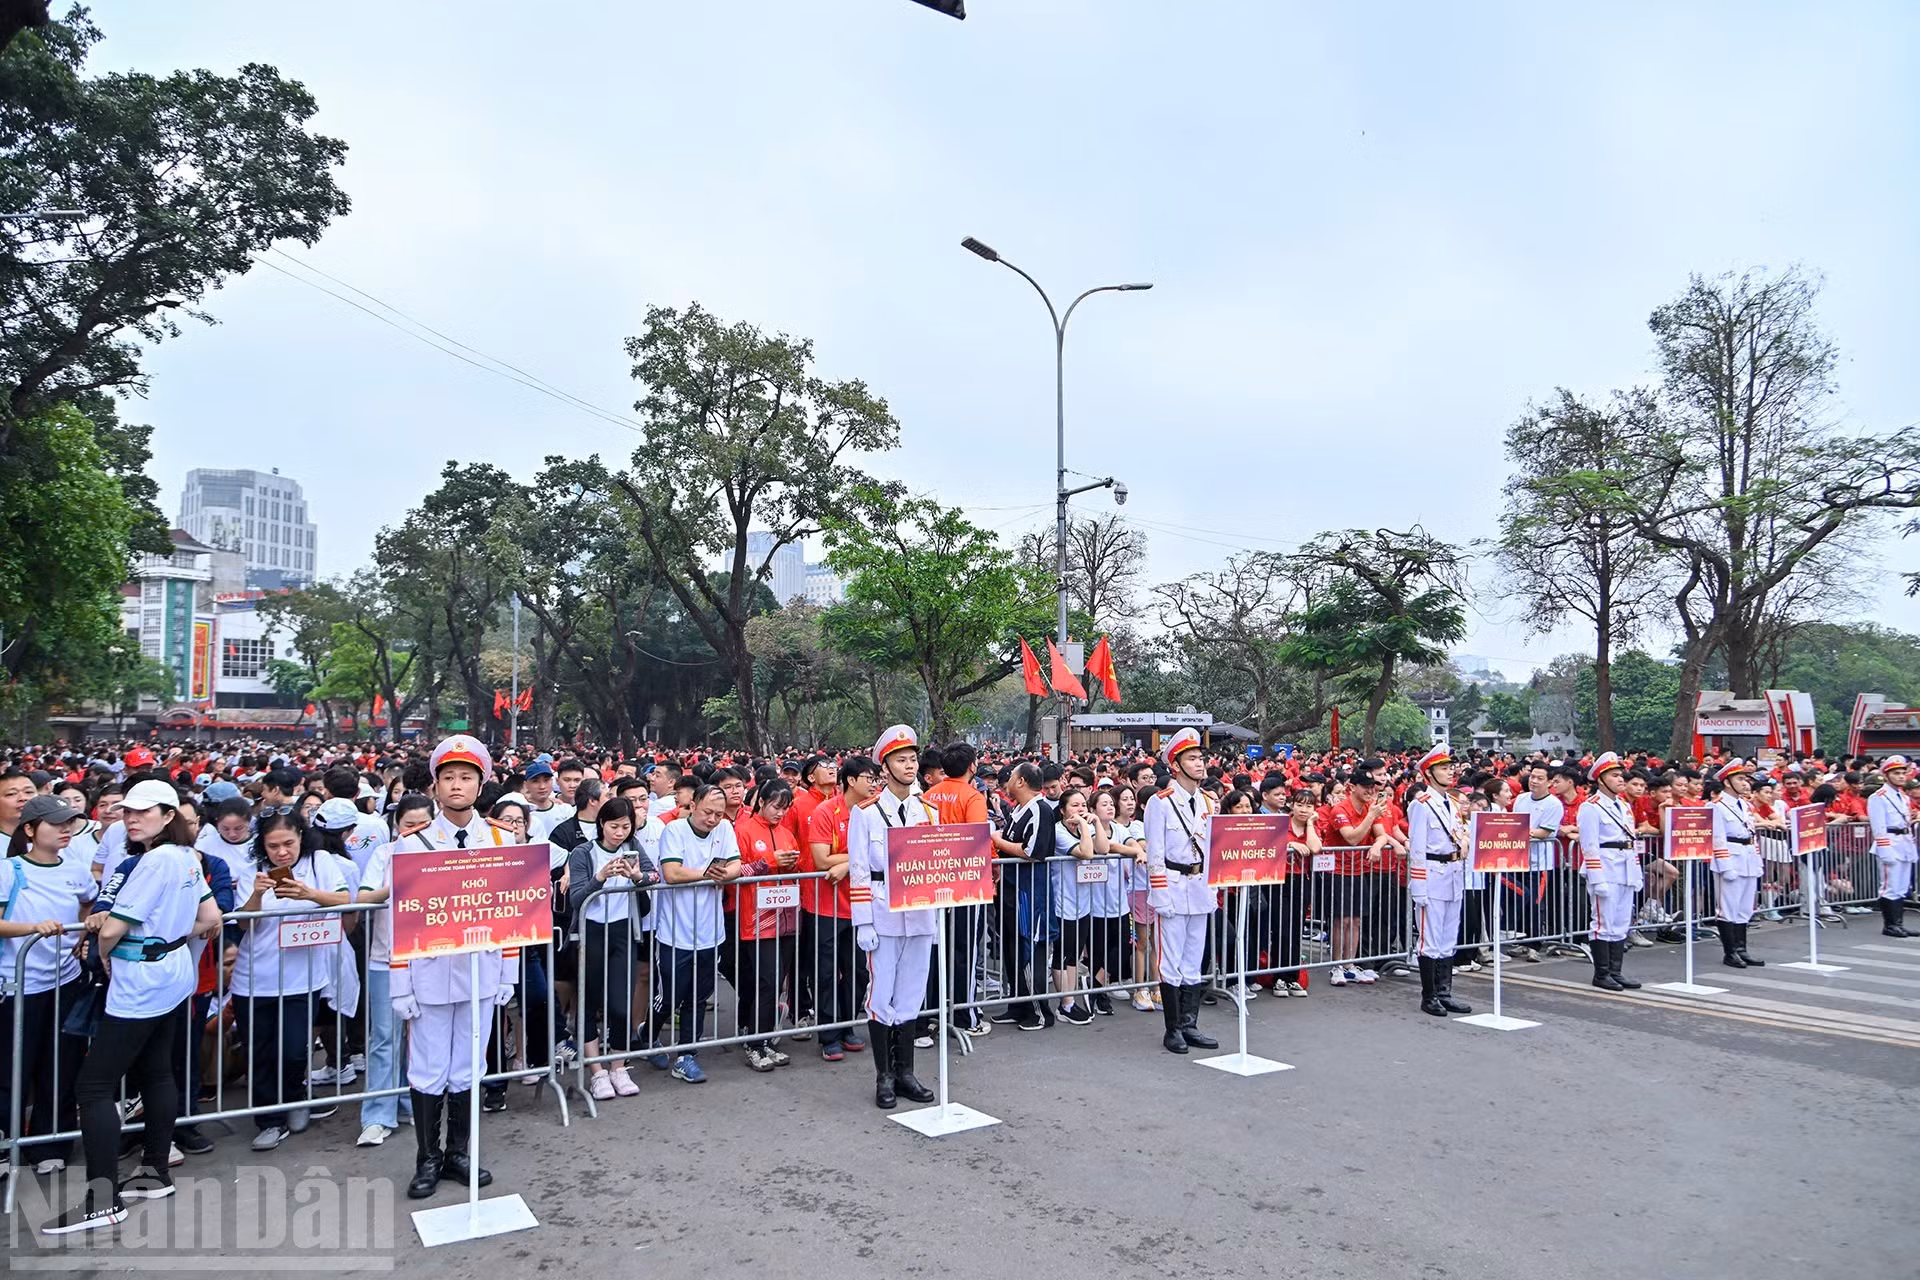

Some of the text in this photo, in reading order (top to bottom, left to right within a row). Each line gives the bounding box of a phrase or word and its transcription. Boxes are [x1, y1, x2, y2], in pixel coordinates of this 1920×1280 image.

[930, 793, 957, 802] HANOI
[928, 857, 961, 871] LUYỆN
[963, 856, 985, 867] VIÊN
[958, 869, 980, 880] VIÊN
[399, 886, 547, 913] HS, SV TRỰC THUỘC
[766, 895, 791, 904] STOP
[426, 905, 523, 926] BỘ VH,TT&DL
[292, 930, 330, 942] STOP
[83, 1206, 119, 1220] TOMMY
